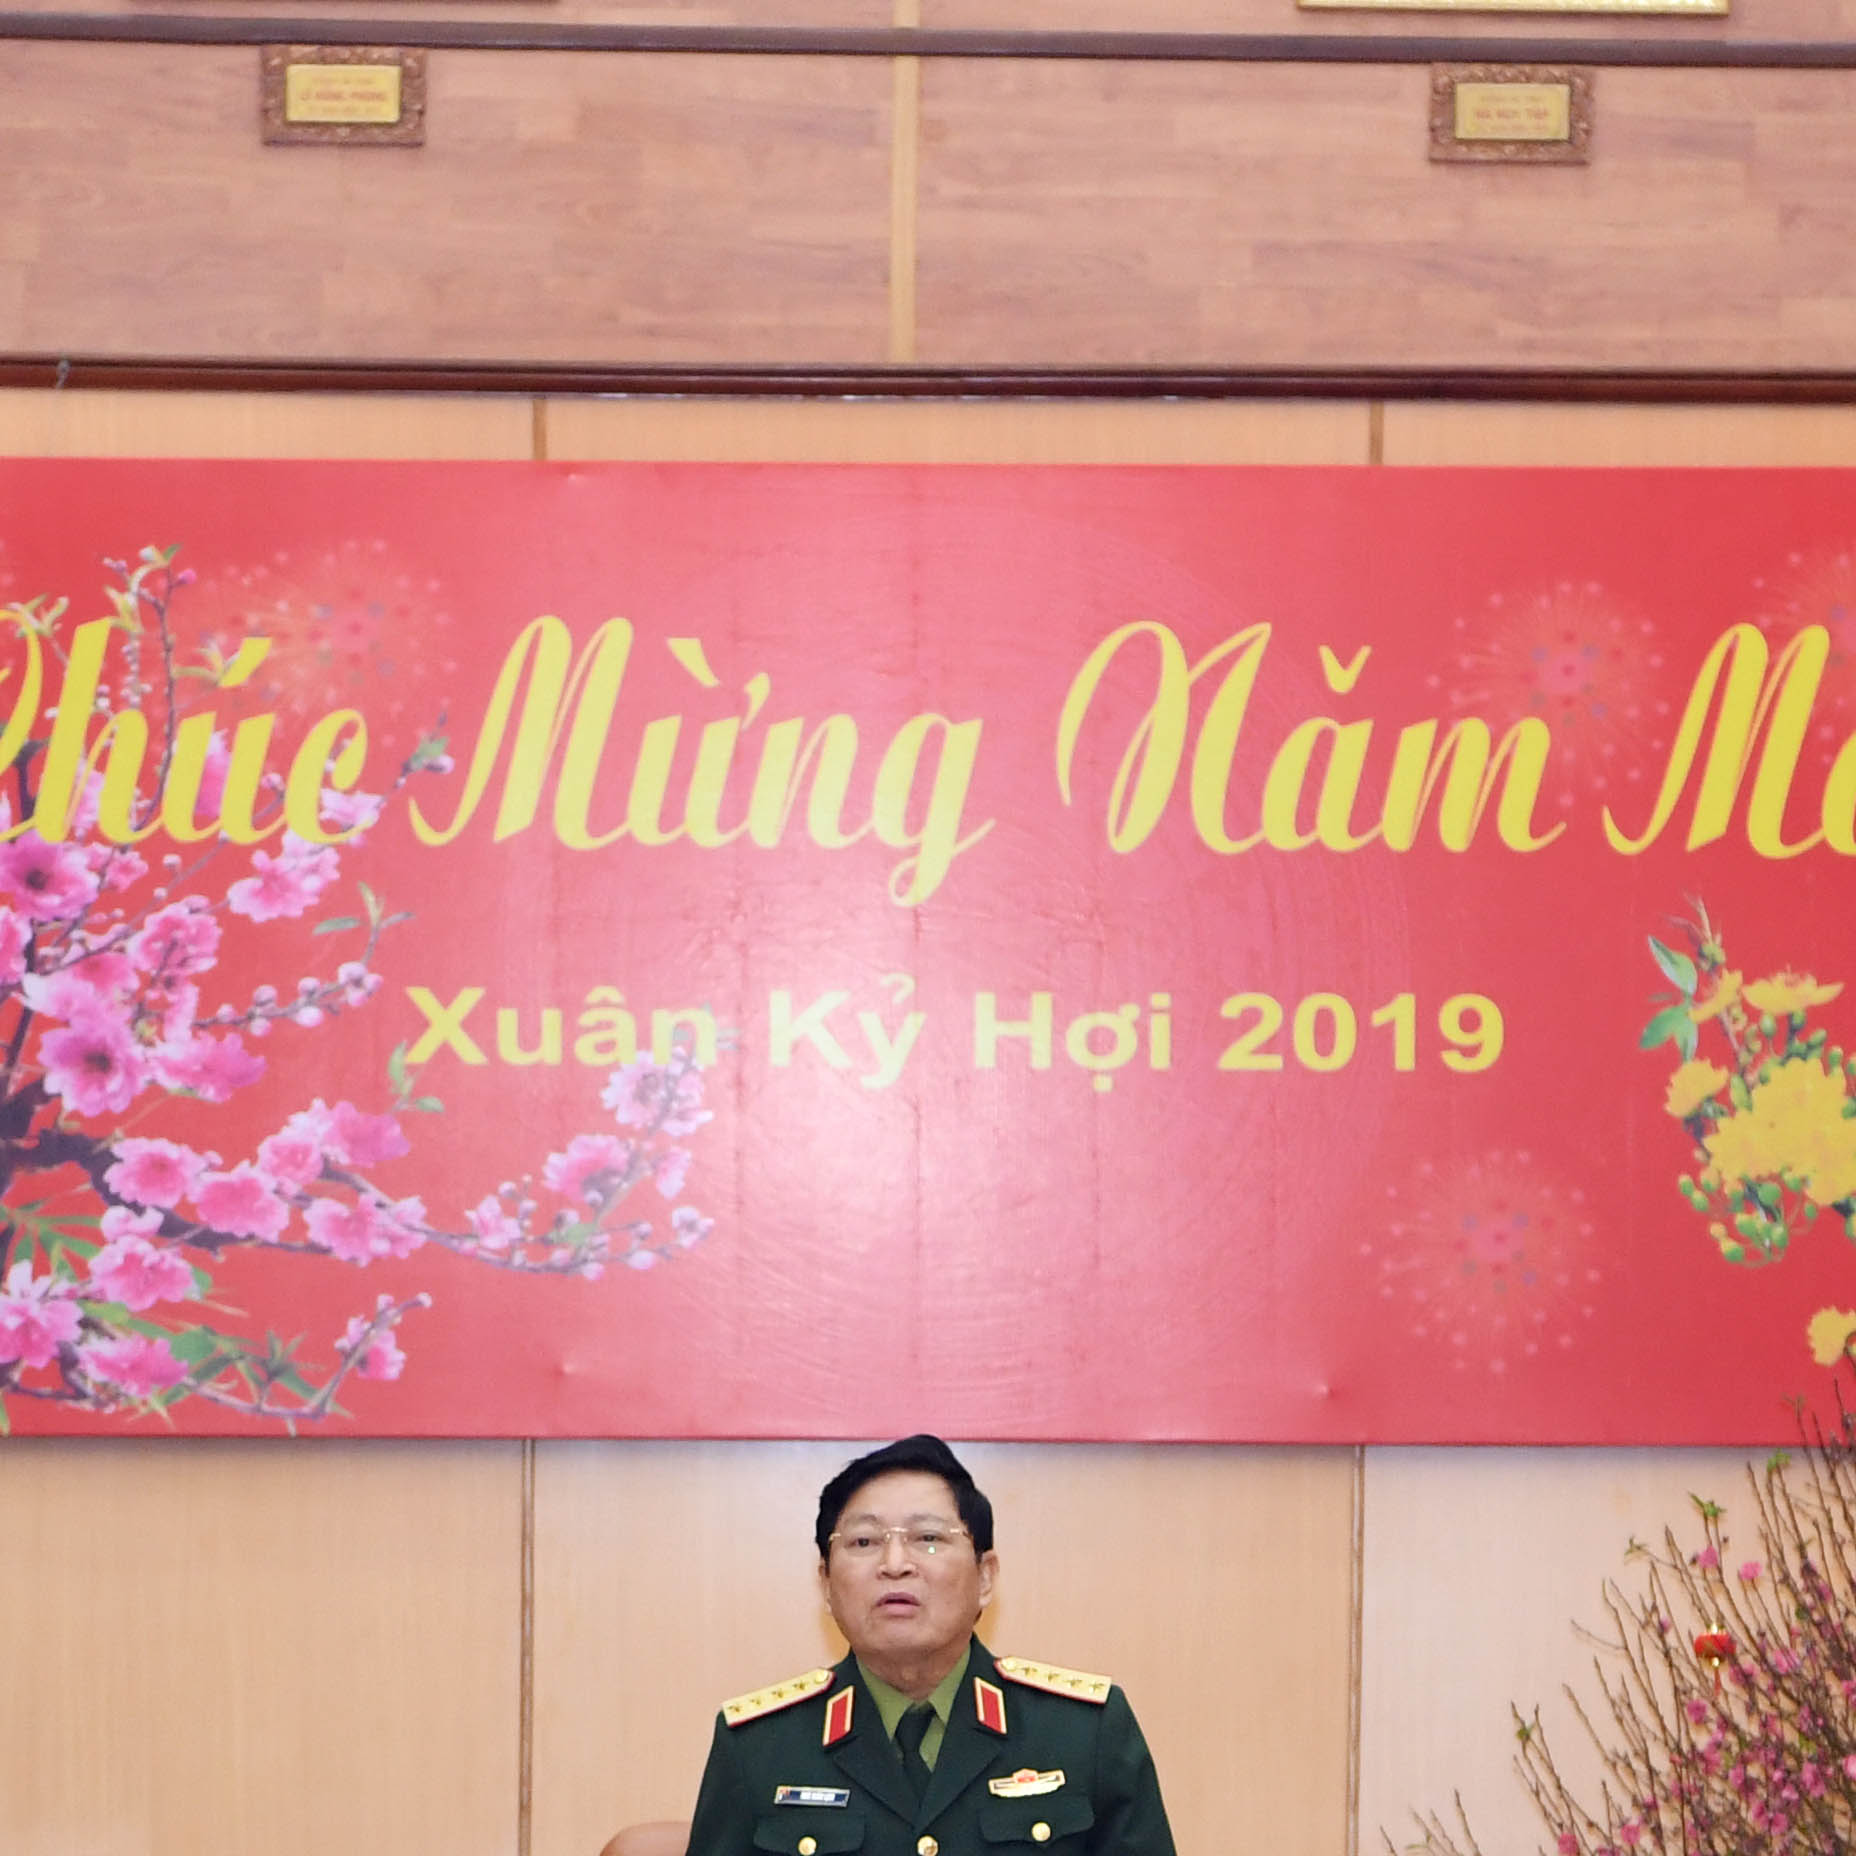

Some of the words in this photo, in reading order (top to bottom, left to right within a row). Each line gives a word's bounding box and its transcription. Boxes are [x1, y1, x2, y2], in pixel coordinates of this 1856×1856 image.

[409, 615, 996, 907] Mừng
[1055, 620, 1568, 855] Năm
[405, 986, 717, 1067] Xuân
[768, 972, 927, 1089] Kỷ
[970, 992, 1170, 1093] Hợi
[1220, 993, 1505, 1073] 2019
